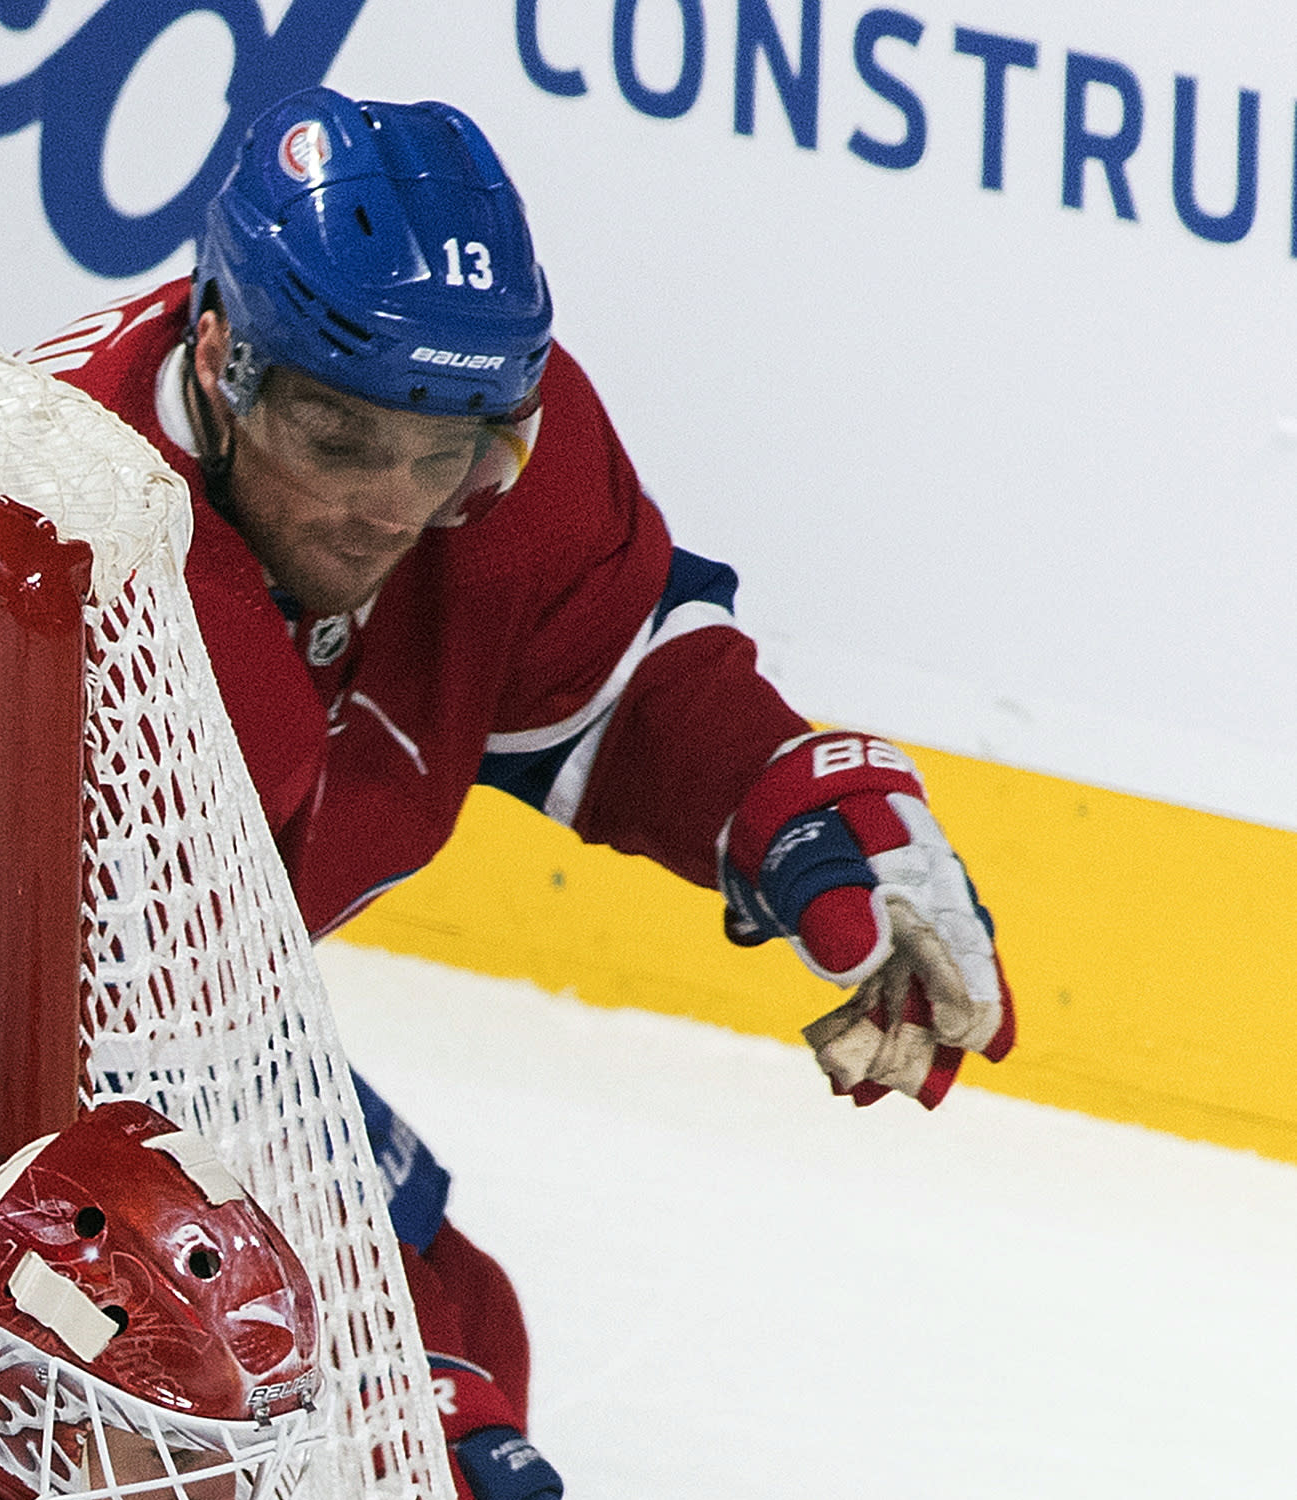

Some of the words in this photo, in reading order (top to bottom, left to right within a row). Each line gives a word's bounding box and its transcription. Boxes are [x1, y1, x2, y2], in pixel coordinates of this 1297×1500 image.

[514, 0, 1297, 258] CONSTRU
[443, 237, 493, 290] 13
[410, 346, 505, 371] BAUER
